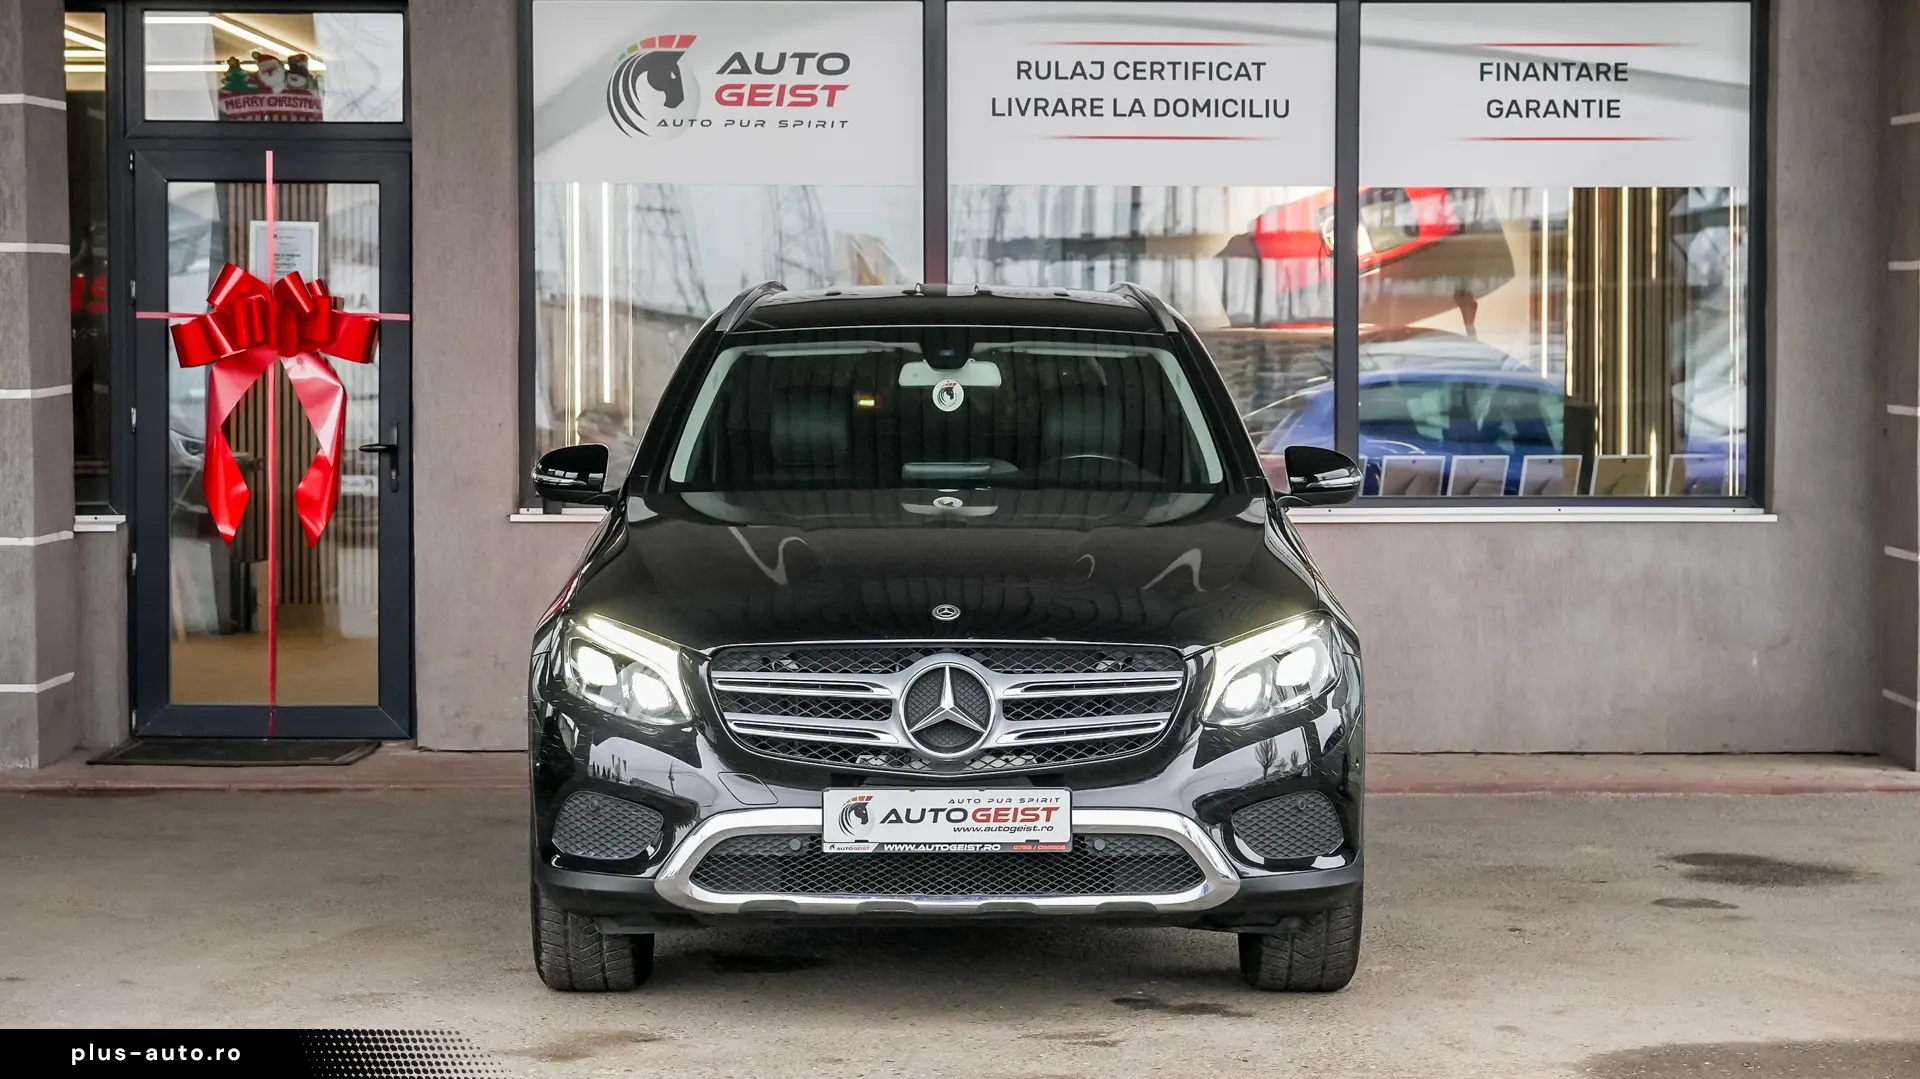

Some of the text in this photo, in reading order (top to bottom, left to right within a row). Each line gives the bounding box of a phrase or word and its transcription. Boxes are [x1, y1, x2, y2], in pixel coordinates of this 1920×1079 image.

[715, 51, 851, 76] AUTO
[1016, 60, 1267, 82] RULAJ CERTIFICAT
[1479, 61, 1629, 82] FINANTARE
[225, 97, 265, 110] MERRY
[714, 83, 850, 108] GEIST
[991, 97, 1290, 119] LIVRARE LA DOMICILIU
[1486, 98, 1621, 119] GARANTIE
[656, 118, 849, 129] AUTO PUR SPIRIT
[953, 825, 1054, 834] www.autogeist.ro
[884, 844, 1001, 852] WWW.AUTOGEIST.RO
